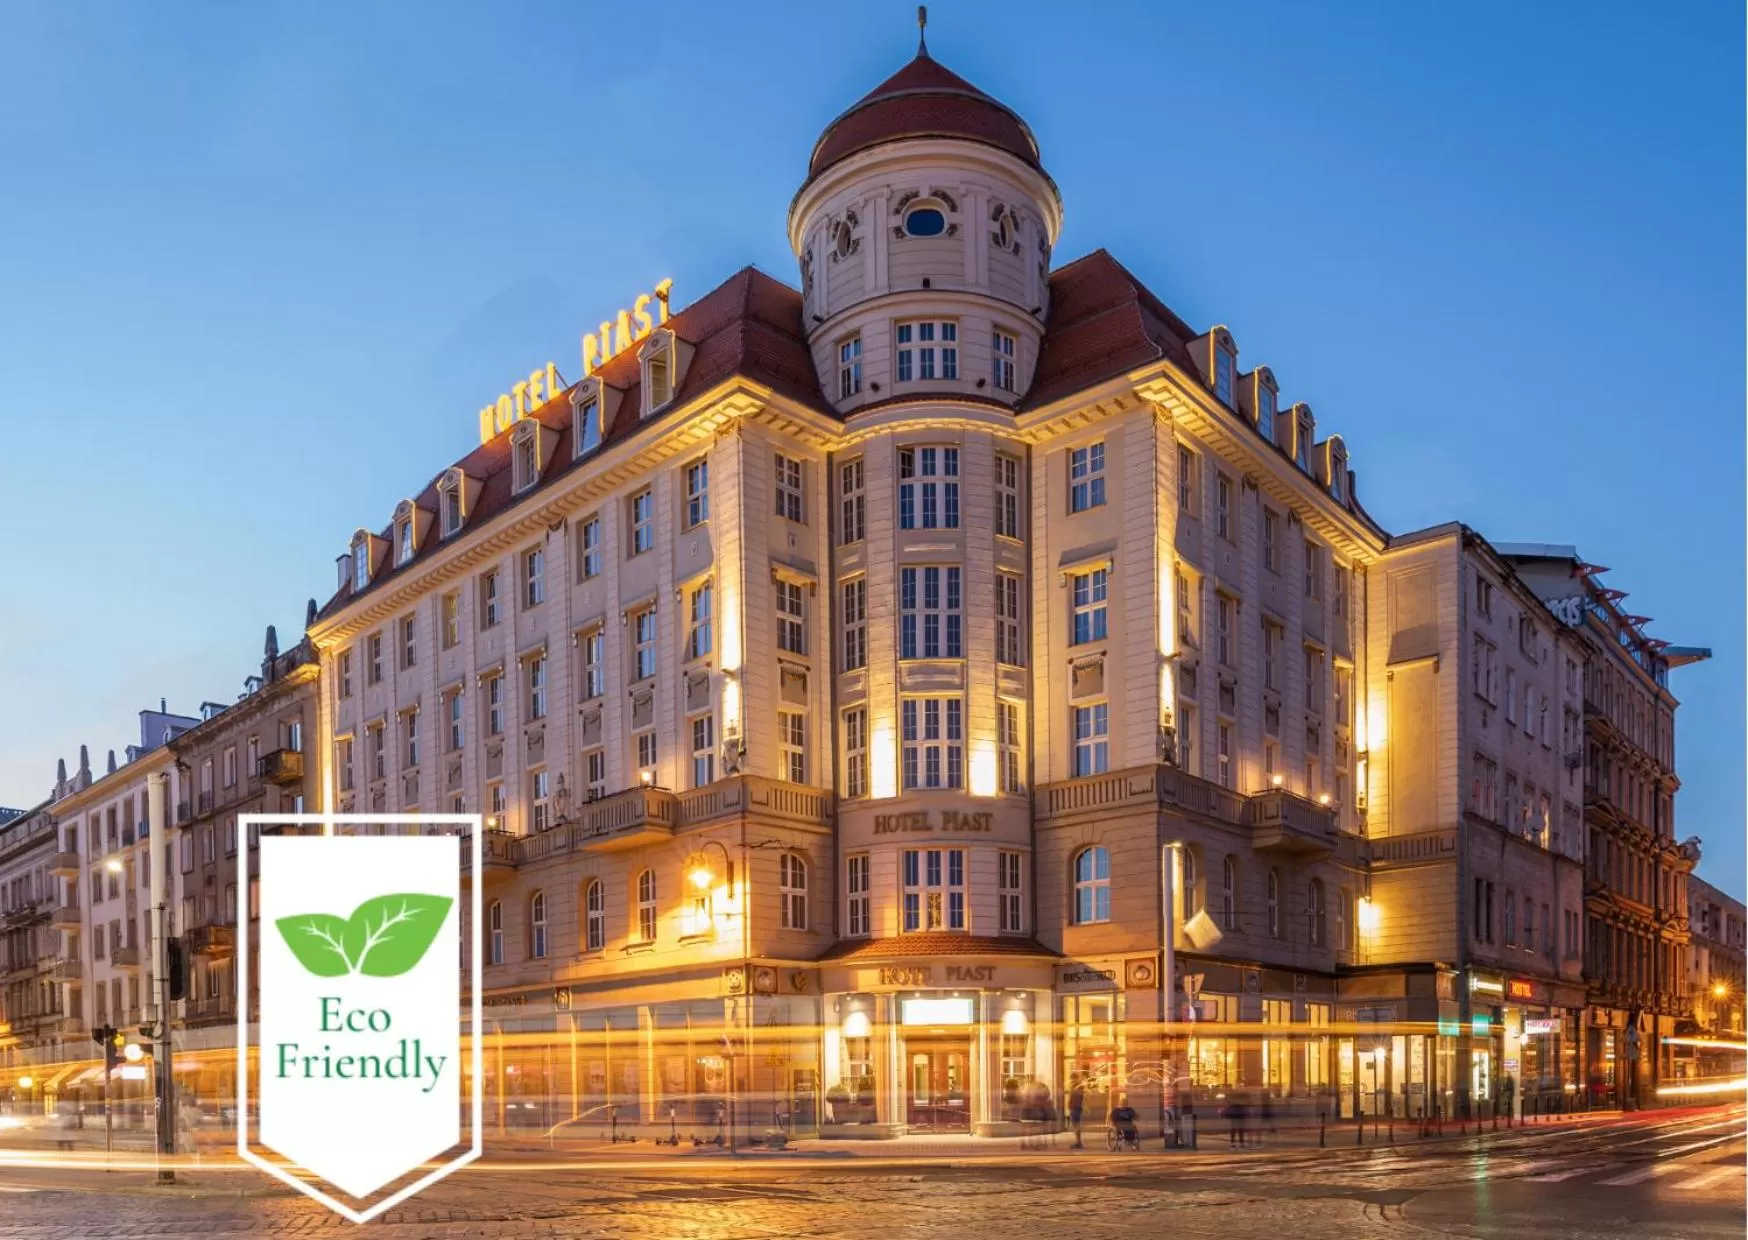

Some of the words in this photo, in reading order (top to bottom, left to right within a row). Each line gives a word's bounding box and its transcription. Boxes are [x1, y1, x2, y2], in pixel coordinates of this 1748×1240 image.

[480, 361, 562, 445] HOTEL
[583, 278, 674, 376] PIAST
[874, 811, 933, 834] HOTEL
[941, 811, 994, 832] PIAST
[879, 966, 932, 985] HOTEL
[946, 966, 997, 982] PIAST
